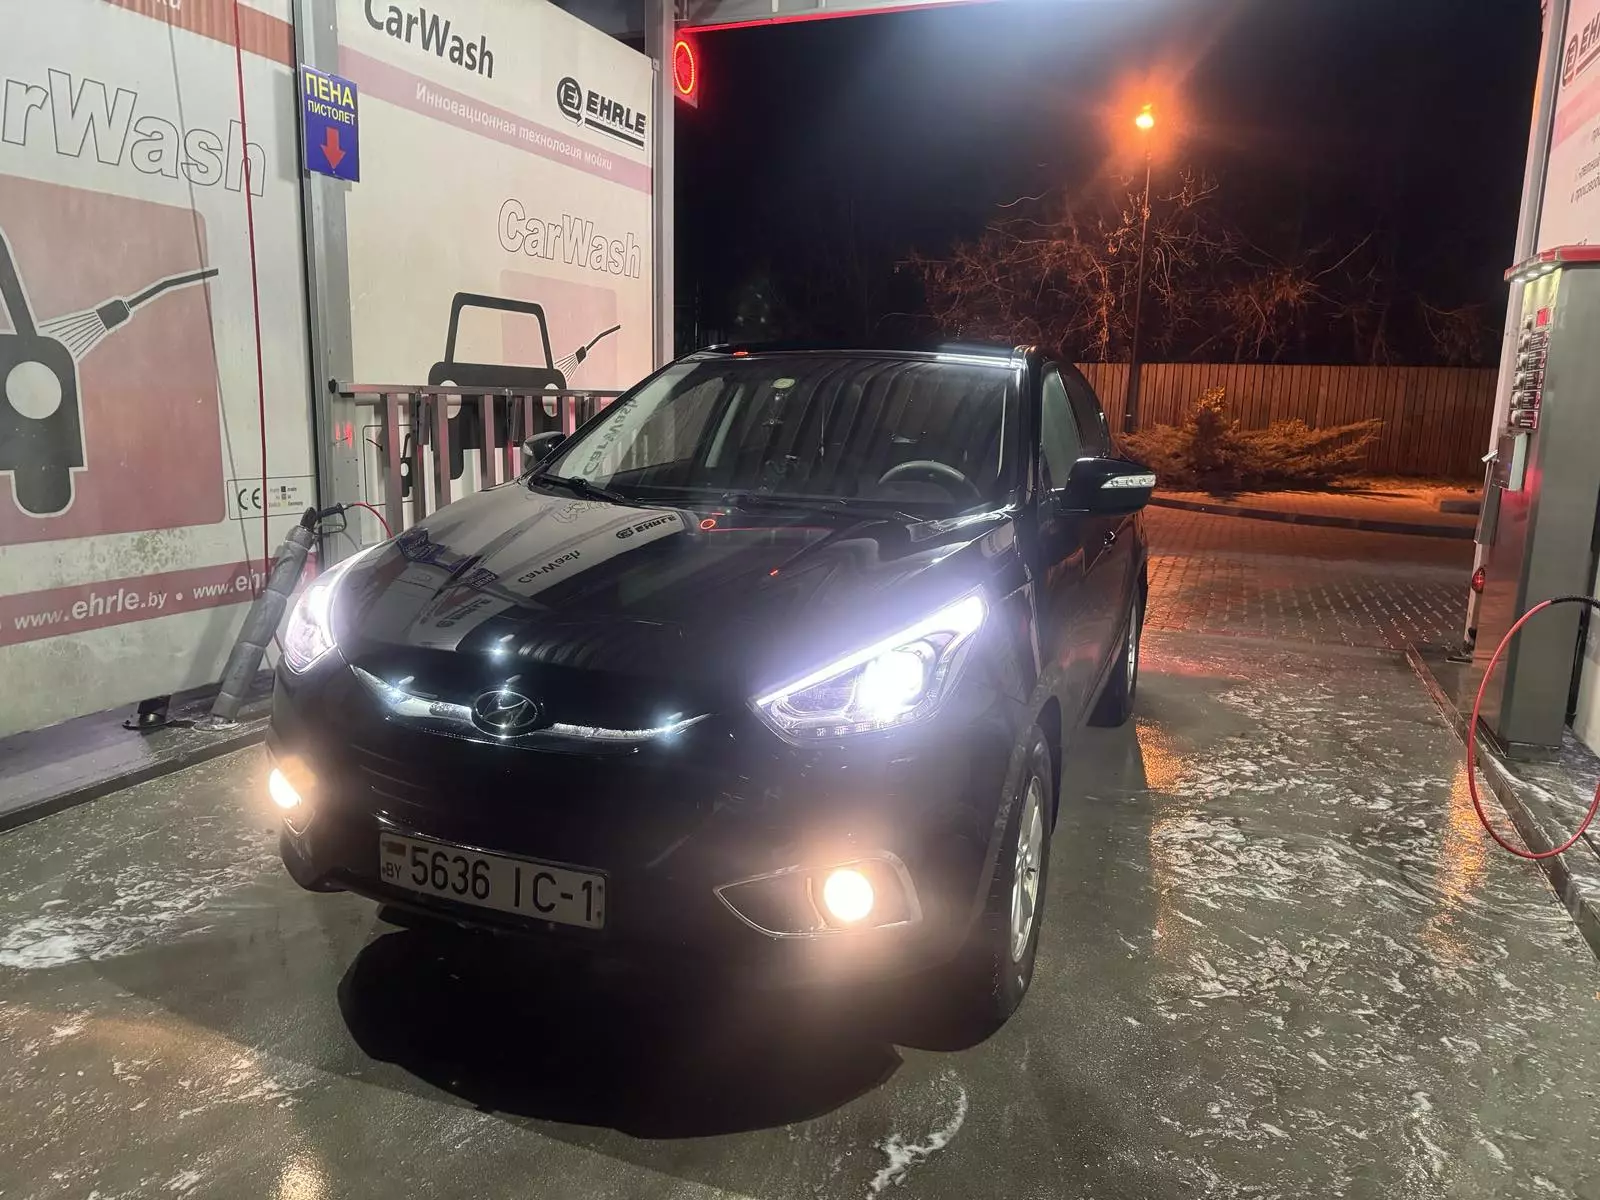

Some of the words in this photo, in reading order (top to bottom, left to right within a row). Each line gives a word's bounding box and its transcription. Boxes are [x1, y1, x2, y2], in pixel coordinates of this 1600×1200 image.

[364, 0, 494, 78] CarWash
[305, 72, 354, 109] ПЕНА
[307, 99, 355, 126] ПИСТОЛЕТ
[587, 90, 646, 135] EHRLE
[416, 82, 516, 135] Инновационная
[519, 126, 582, 160] технология
[585, 151, 612, 170] мойки
[498, 198, 641, 279] CarWash
[14, 588, 167, 630] www.ehrle.by
[386, 862, 401, 879] BY
[411, 846, 490, 899] 5636
[514, 866, 593, 921] IC-1
